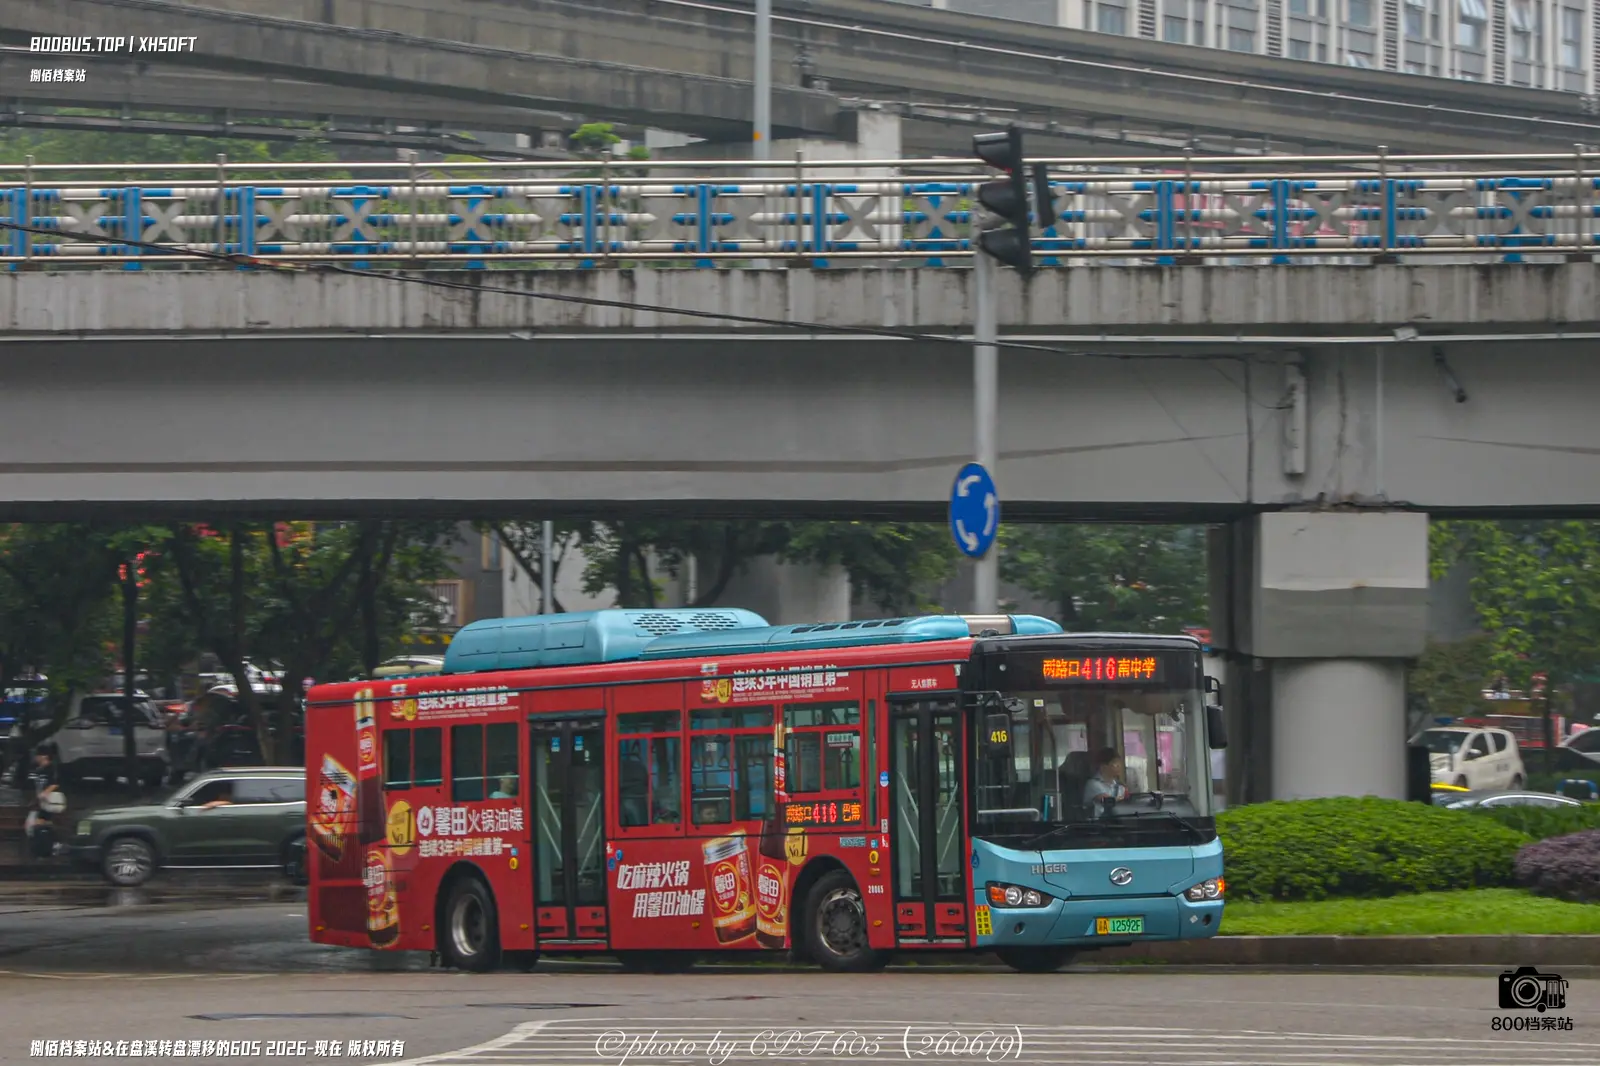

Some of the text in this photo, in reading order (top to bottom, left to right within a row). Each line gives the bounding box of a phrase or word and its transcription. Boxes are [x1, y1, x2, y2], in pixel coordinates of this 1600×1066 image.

[1043, 657, 1156, 680] 两路口 416 南中学
[991, 731, 1007, 743] 416
[813, 802, 837, 823] 416
[616, 860, 690, 889] 吃麻辣火锅
[1031, 863, 1067, 874] HIGER
[632, 888, 706, 918] 用馨田油碟
[1112, 919, 1141, 932] 12592F
